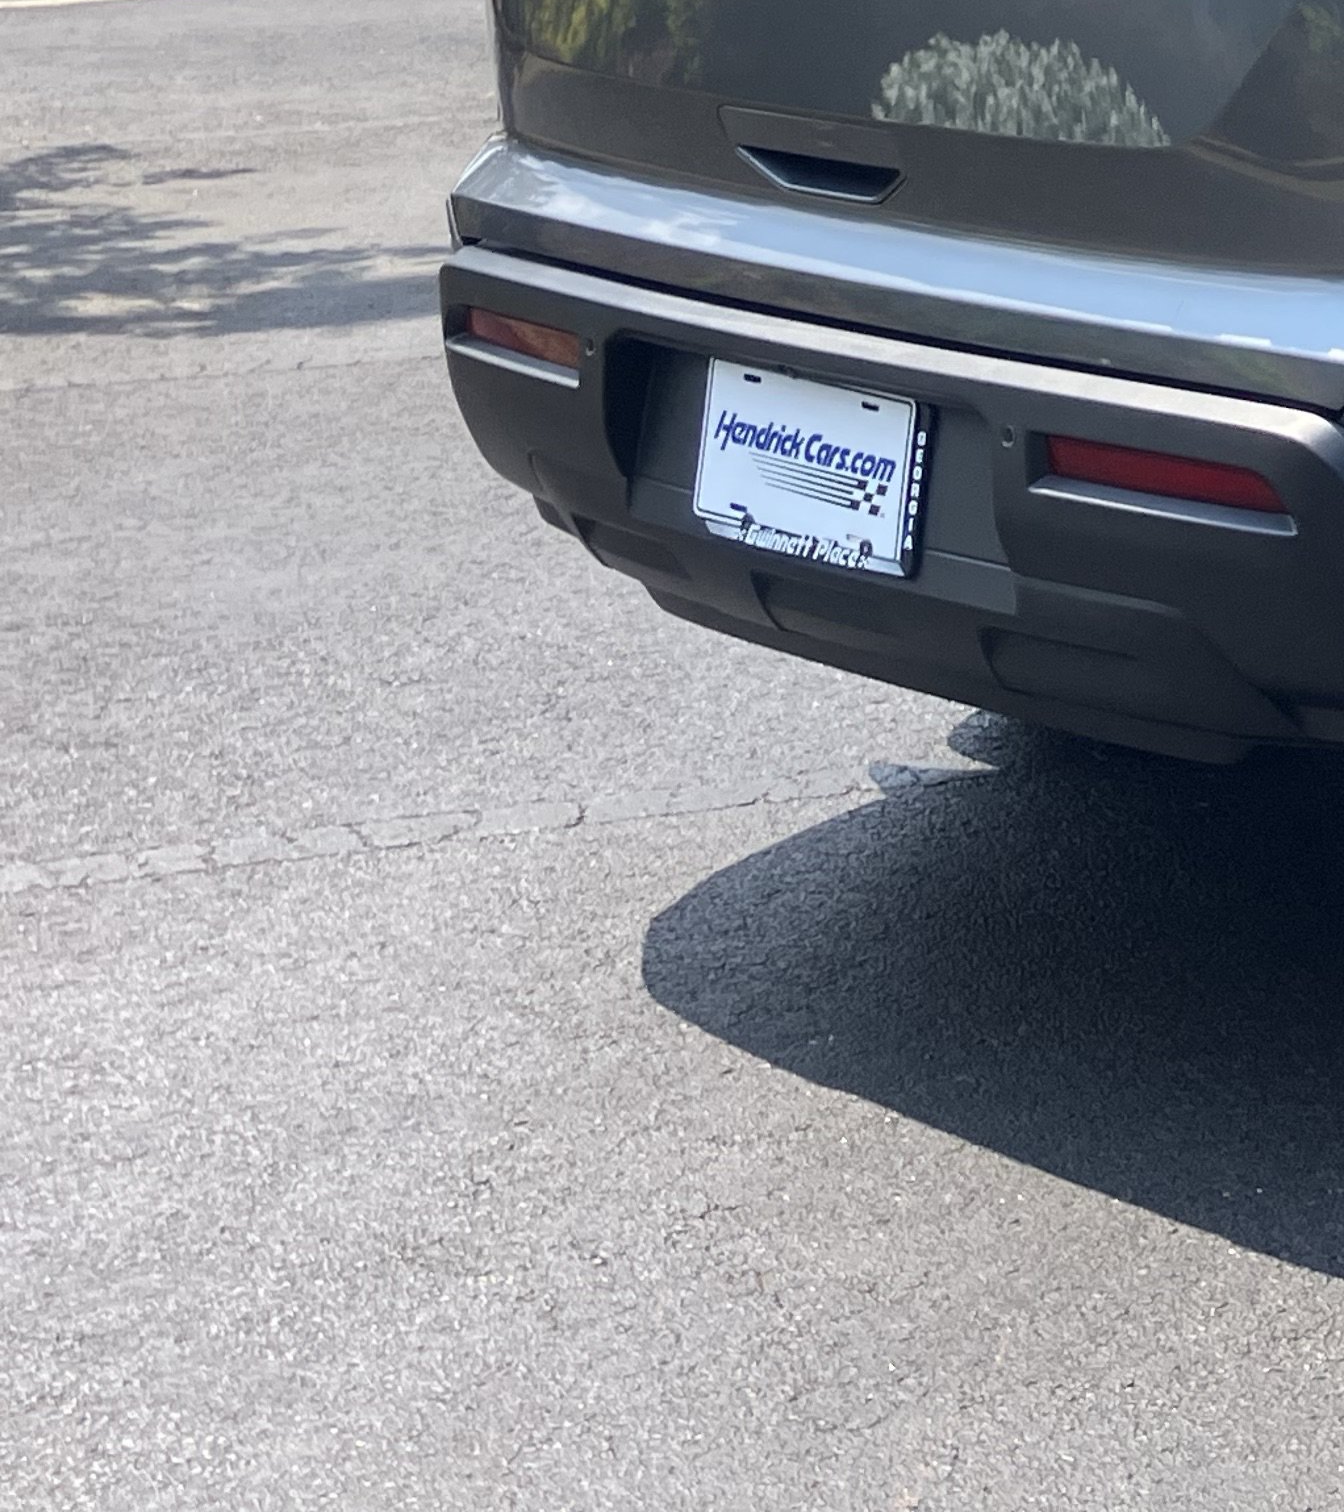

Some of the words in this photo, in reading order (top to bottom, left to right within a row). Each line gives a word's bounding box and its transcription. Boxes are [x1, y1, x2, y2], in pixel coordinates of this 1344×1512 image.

[903, 431, 927, 551] GEORGIA
[745, 524, 813, 558] Gwinnett
[814, 539, 859, 569] Place
